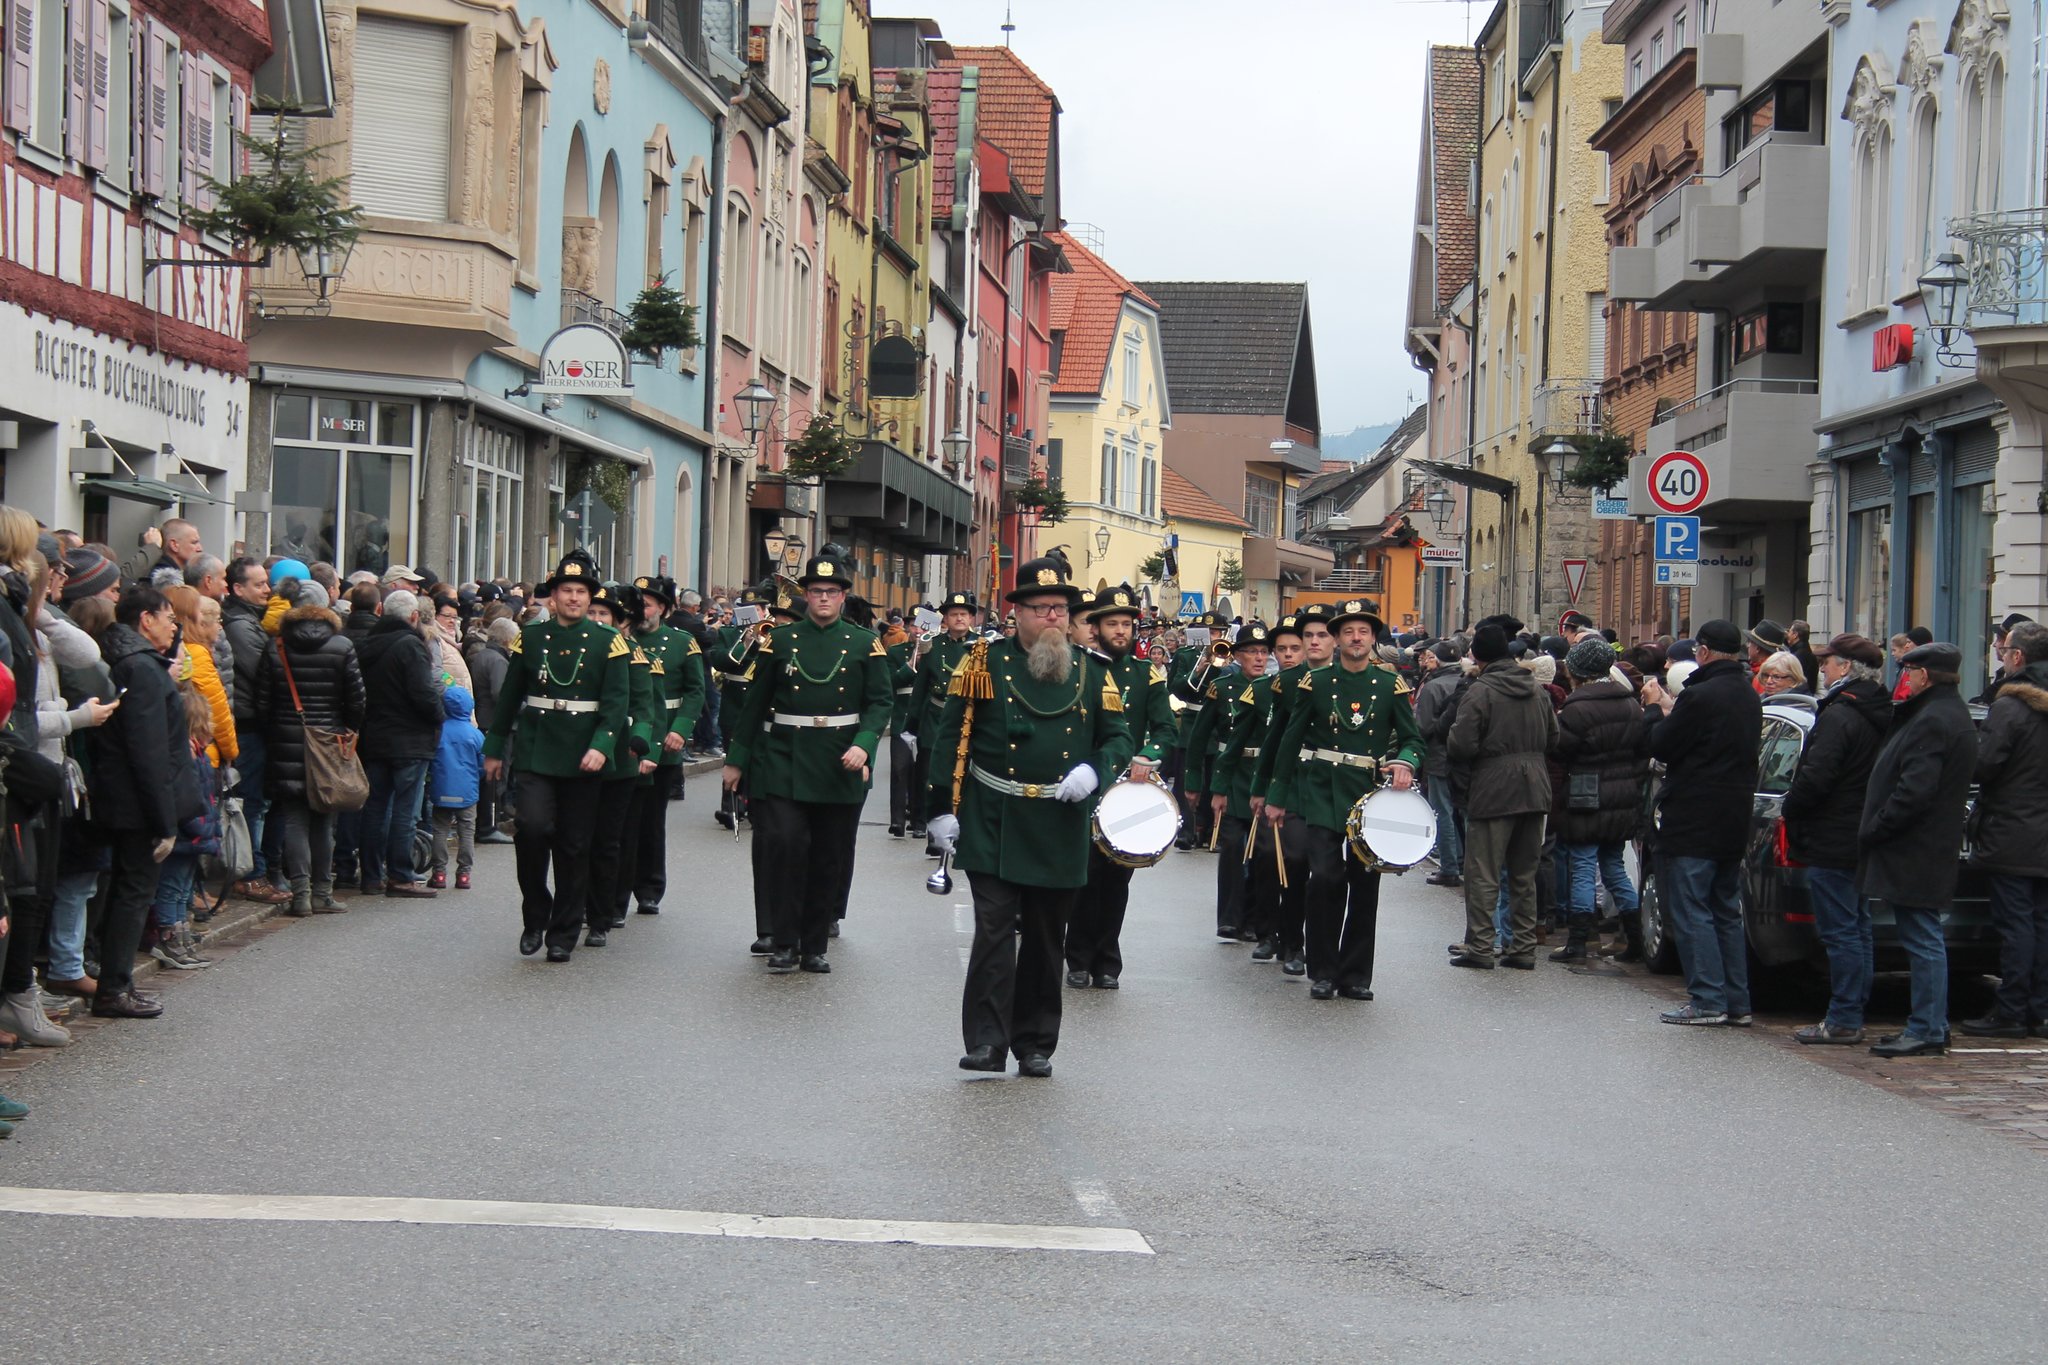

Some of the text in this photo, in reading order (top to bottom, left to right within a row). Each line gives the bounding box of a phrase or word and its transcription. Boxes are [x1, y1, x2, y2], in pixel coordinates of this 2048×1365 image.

[1872, 324, 1907, 372] NKD
[546, 359, 620, 379] MOSER
[35, 329, 243, 438] RICHTER BUCHHANDLUNG 34
[546, 377, 621, 389] HERRENMODEN
[1660, 468, 1697, 497] 40
[1664, 521, 1690, 556] P
[1426, 548, 1460, 557] müller
[1698, 555, 1754, 567] eobald
